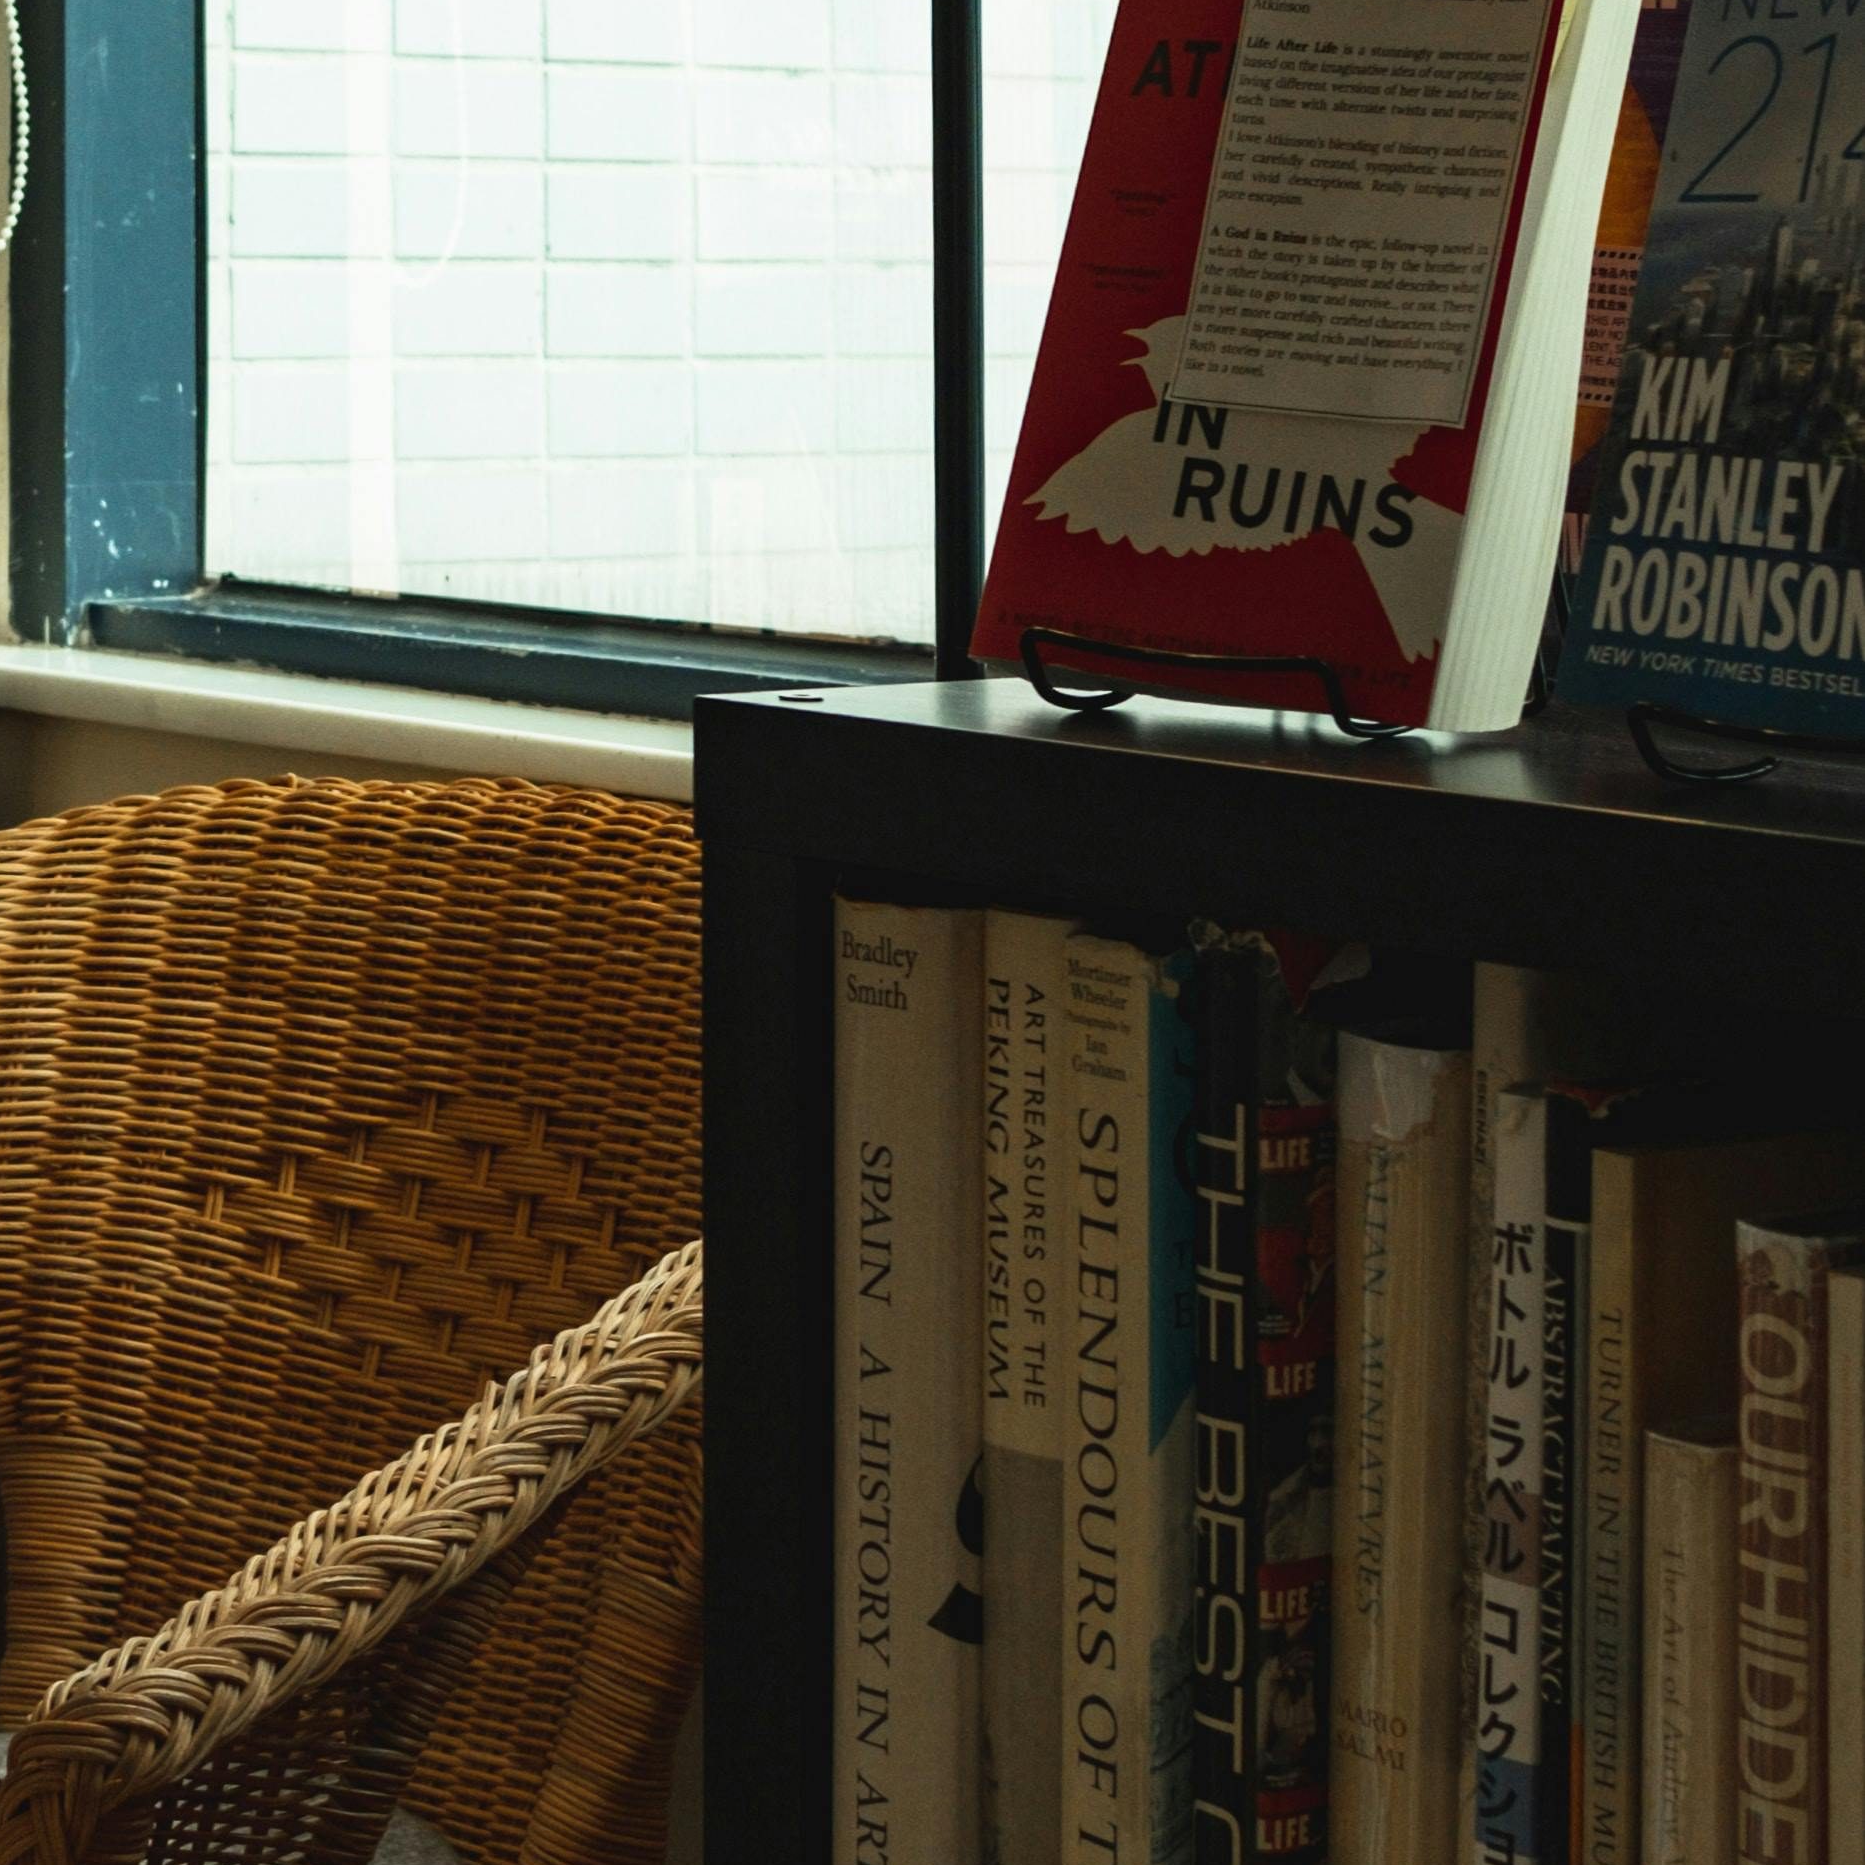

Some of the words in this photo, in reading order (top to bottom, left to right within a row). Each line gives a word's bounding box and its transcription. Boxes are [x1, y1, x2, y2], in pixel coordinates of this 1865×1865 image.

[1254, 0, 1310, 14] Atkinson
[1631, 354, 1731, 443] KIM
[1172, 458, 1416, 549] RUINS
[1610, 451, 1844, 554] STANLEY
[841, 932, 917, 976] Bradley
[845, 975, 908, 1011] Smith
[1259, 1138, 1310, 1170] LIFE
[858, 1140, 894, 1308] SPAIN
[1194, 1102, 1245, 1372] THE
[859, 1341, 892, 1383] A
[1077, 1109, 1119, 1675] SPLENDOURS
[1738, 1312, 1810, 1537] OUR
[856, 1407, 892, 1668] HISTORY
[1193, 1410, 1245, 1775] BEST
[856, 1685, 889, 1754] IN
[1076, 1695, 1119, 1797] OF
